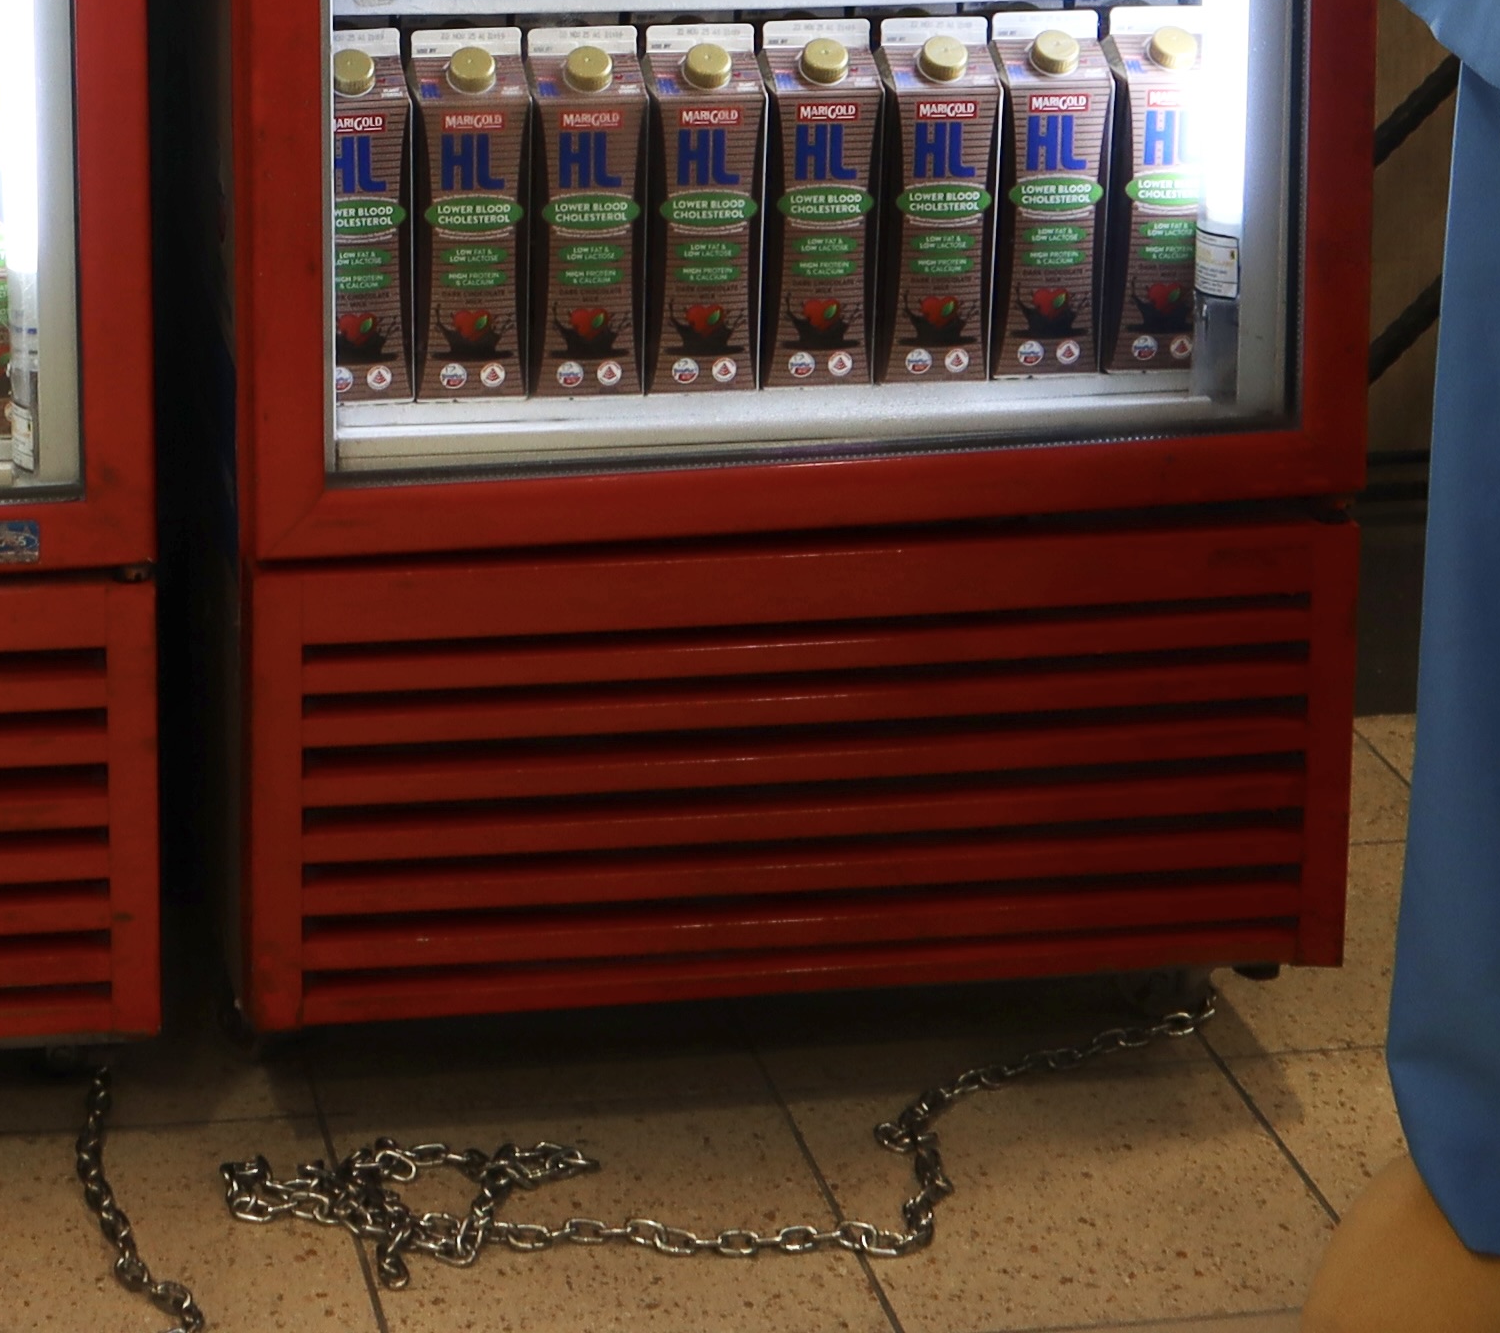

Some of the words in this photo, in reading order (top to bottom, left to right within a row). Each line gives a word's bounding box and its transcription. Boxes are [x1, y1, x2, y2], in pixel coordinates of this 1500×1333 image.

[919, 103, 975, 118] MARIGOLD
[1031, 95, 1087, 111] MARIGOLD
[443, 136, 503, 188] HL
[560, 133, 620, 187] HL
[679, 130, 739, 184] HL
[796, 124, 857, 180] HL
[915, 122, 976, 178] HL
[1025, 113, 1088, 172] HL
[1021, 184, 1057, 194] LOWER
[1057, 184, 1092, 194] BLOOD
[1021, 194, 1091, 204] CHOLESTEROL
